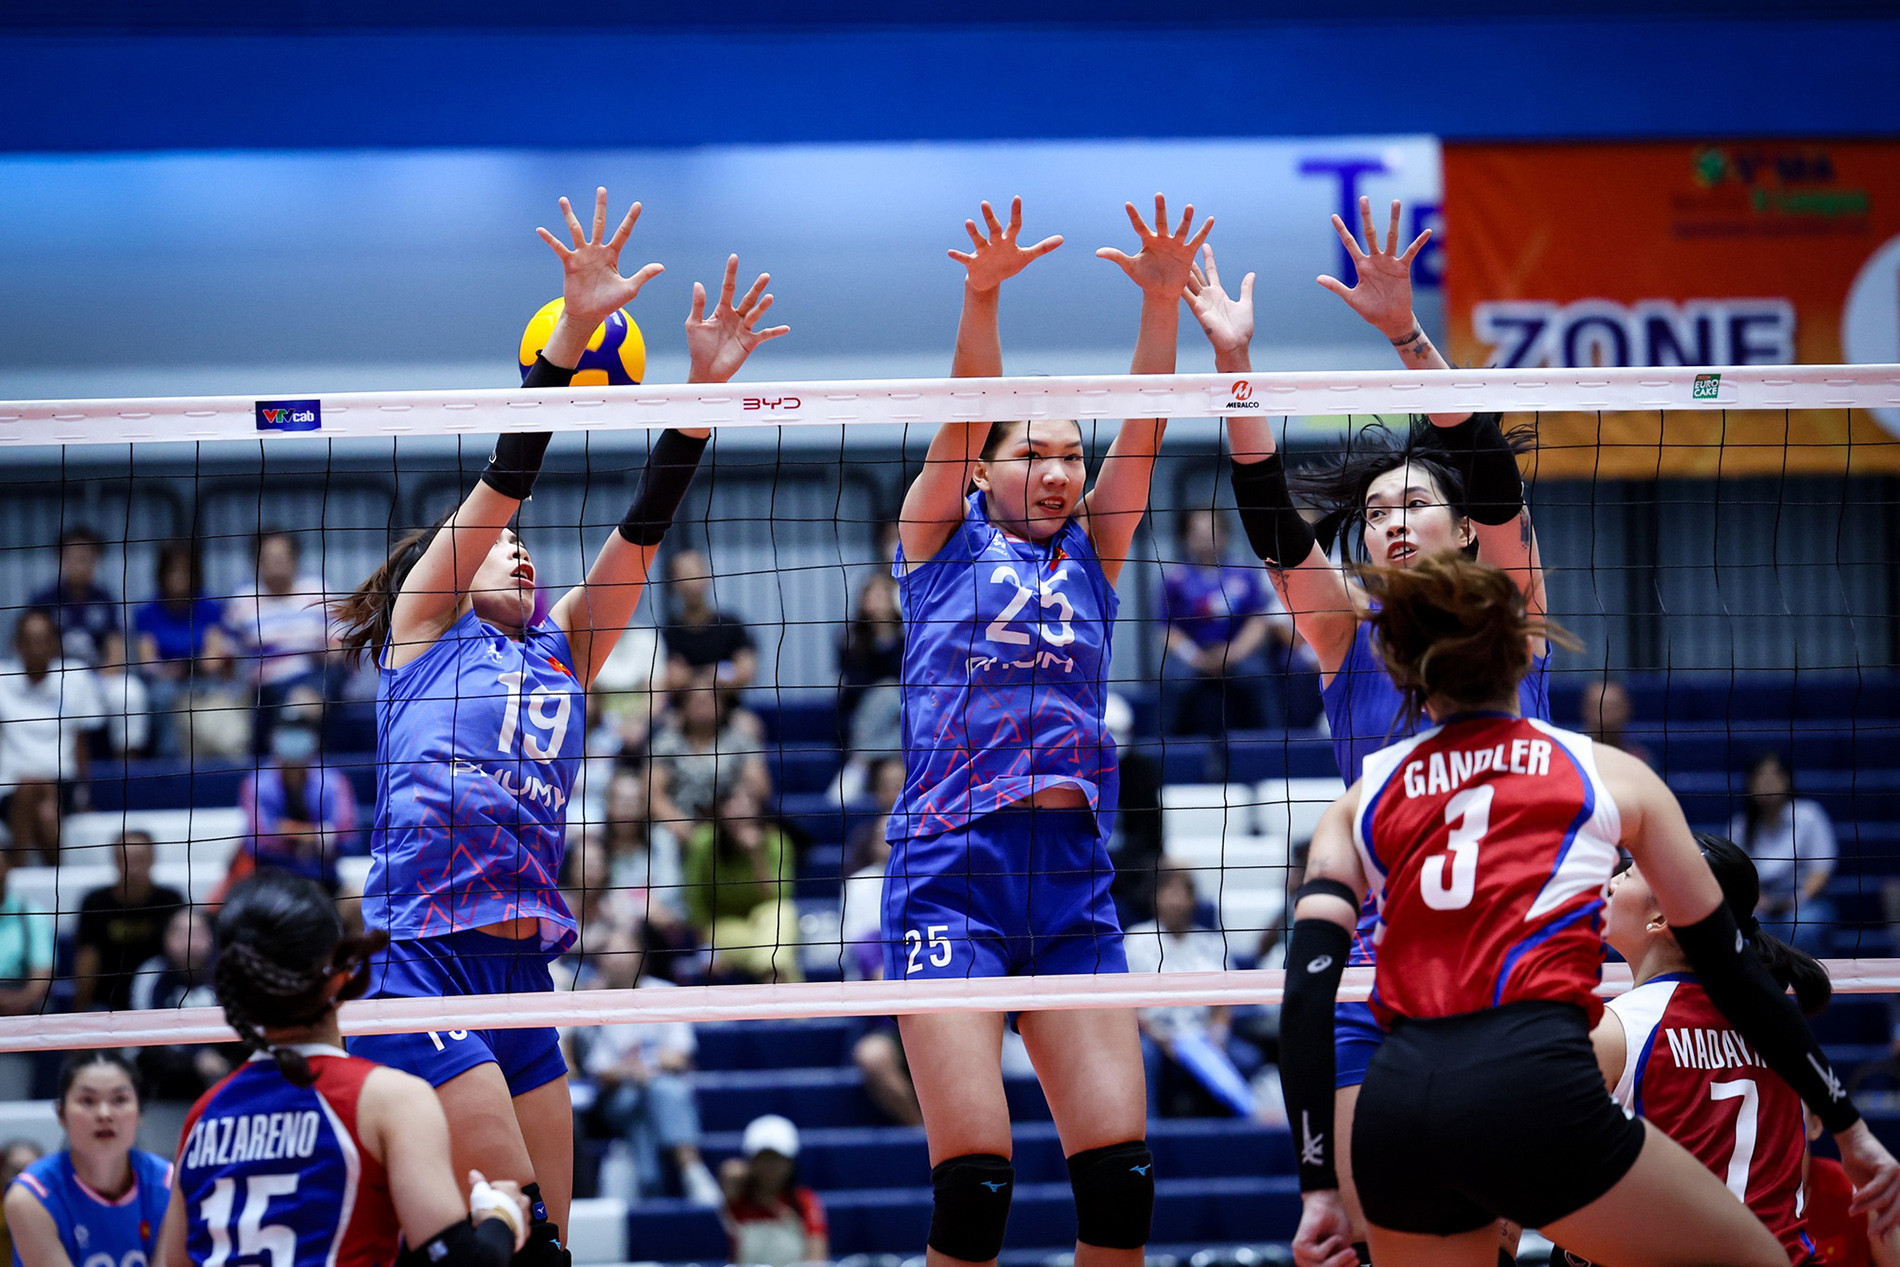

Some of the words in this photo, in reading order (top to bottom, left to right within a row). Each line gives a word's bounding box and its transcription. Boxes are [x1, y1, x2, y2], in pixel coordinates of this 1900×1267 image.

[743, 397, 801, 410] BYD
[1694, 387, 1717, 397] CAKE
[1695, 379, 1719, 389] EURO
[985, 565, 1076, 648] 25
[497, 671, 571, 765] 19
[1403, 738, 1552, 799] GANDLER
[1420, 784, 1495, 911] 3
[903, 925, 953, 975] 25
[1664, 1027, 1768, 1070] MADAY
[187, 1110, 320, 1169] JAZARENO
[1710, 1078, 1759, 1203] 7
[200, 1173, 300, 1267] 15
